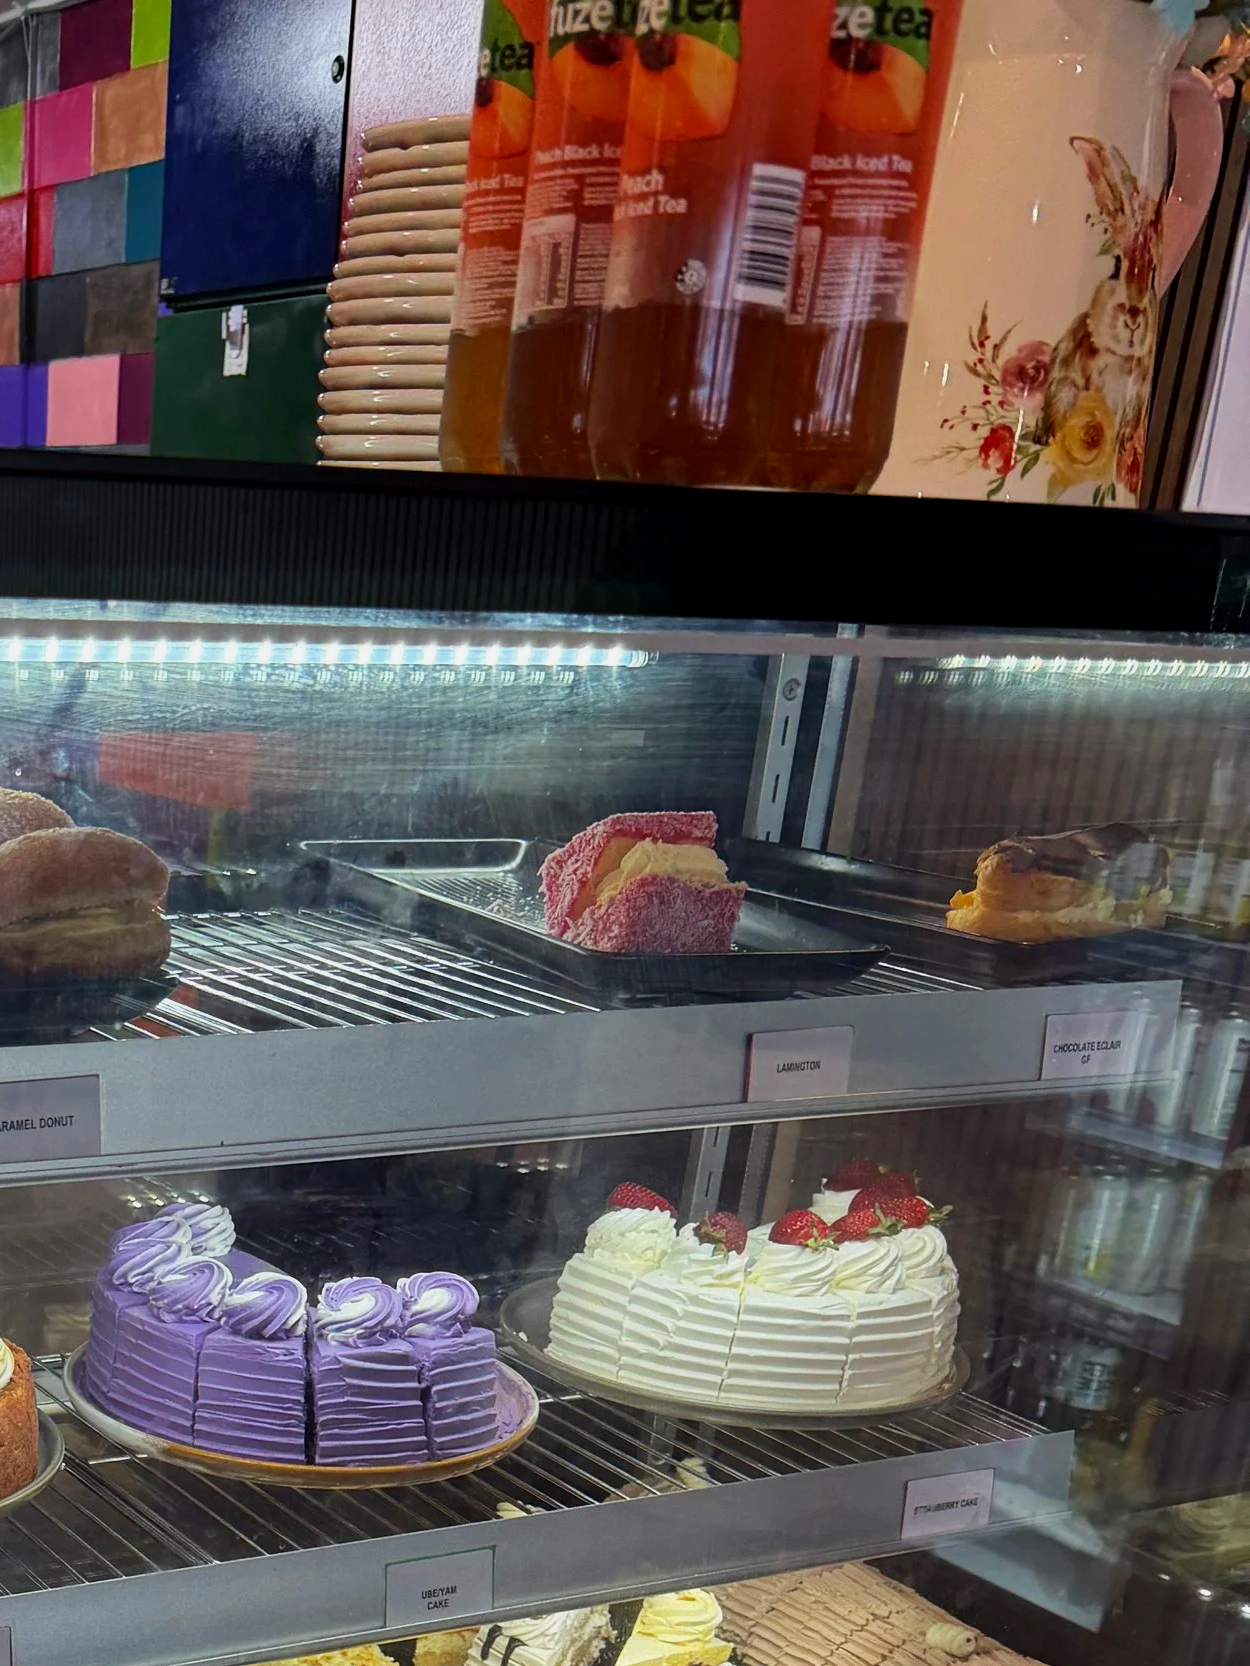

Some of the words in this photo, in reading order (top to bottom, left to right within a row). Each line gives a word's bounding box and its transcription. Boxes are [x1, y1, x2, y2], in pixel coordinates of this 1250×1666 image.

[1053, 1041, 1096, 1054] CHOCOLATE
[1096, 1039, 1122, 1051] ECLAIR
[1081, 1054, 1092, 1065] GF
[776, 1060, 821, 1073] LAMINGTON
[39, 1115, 75, 1129] DONUT
[960, 1497, 979, 1508] CAKE
[421, 1585, 458, 1600] UBE/YAM
[427, 1598, 450, 1611] CAKE
